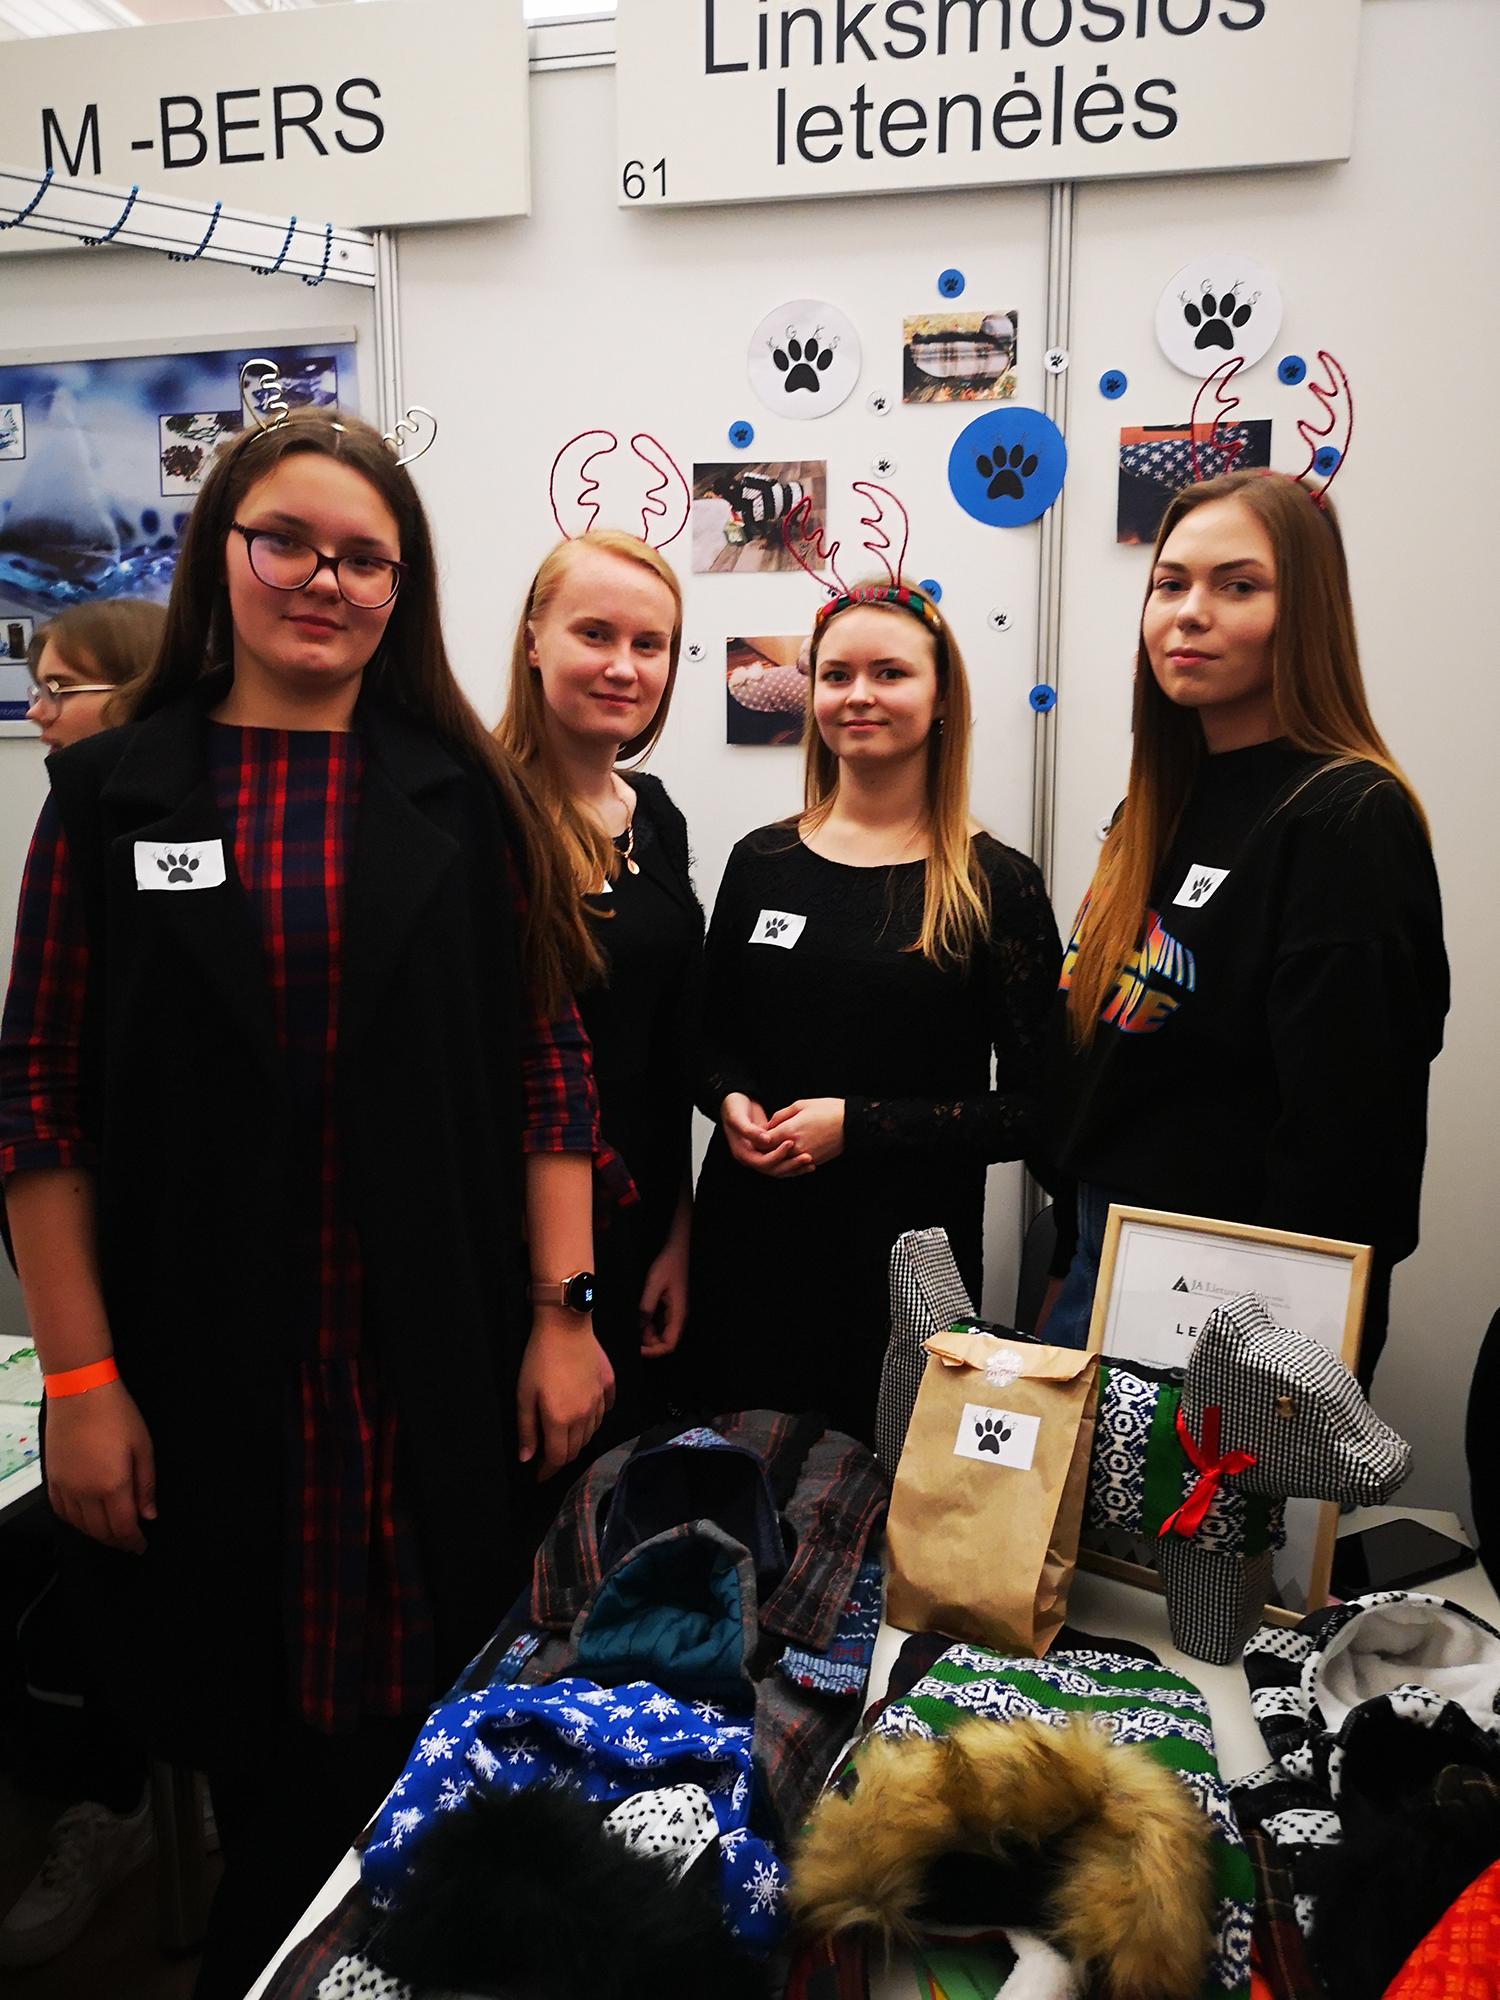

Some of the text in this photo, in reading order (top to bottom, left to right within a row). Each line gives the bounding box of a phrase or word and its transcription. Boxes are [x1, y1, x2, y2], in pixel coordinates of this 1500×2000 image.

[706, 0, 1266, 74] Linksmosios
[42, 78, 385, 177] M -BERS
[776, 65, 1178, 165] letenėlės
[623, 159, 667, 199] 61
[1176, 1323, 1198, 1337] LE
